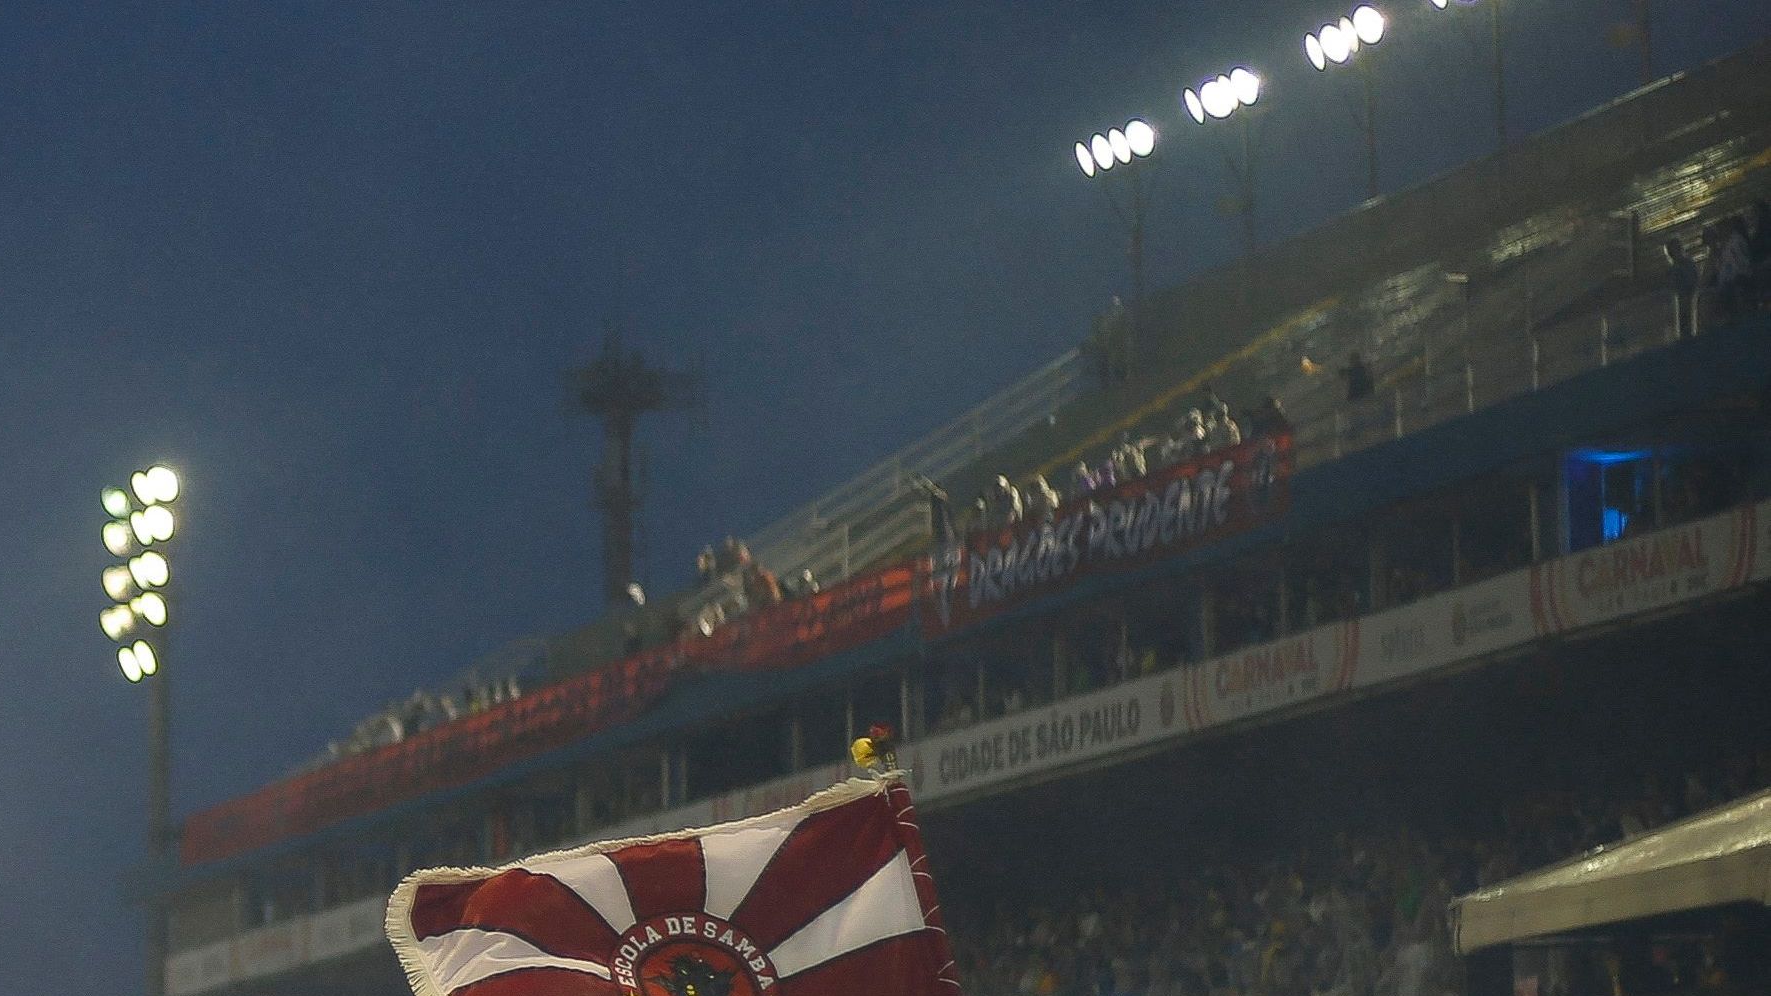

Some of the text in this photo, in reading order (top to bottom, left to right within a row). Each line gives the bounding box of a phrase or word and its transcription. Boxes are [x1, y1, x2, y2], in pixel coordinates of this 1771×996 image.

[938, 698, 1141, 785] CIDADE DE SÃO PAULO
[614, 915, 775, 990] ESCOLA DE SAMBA
